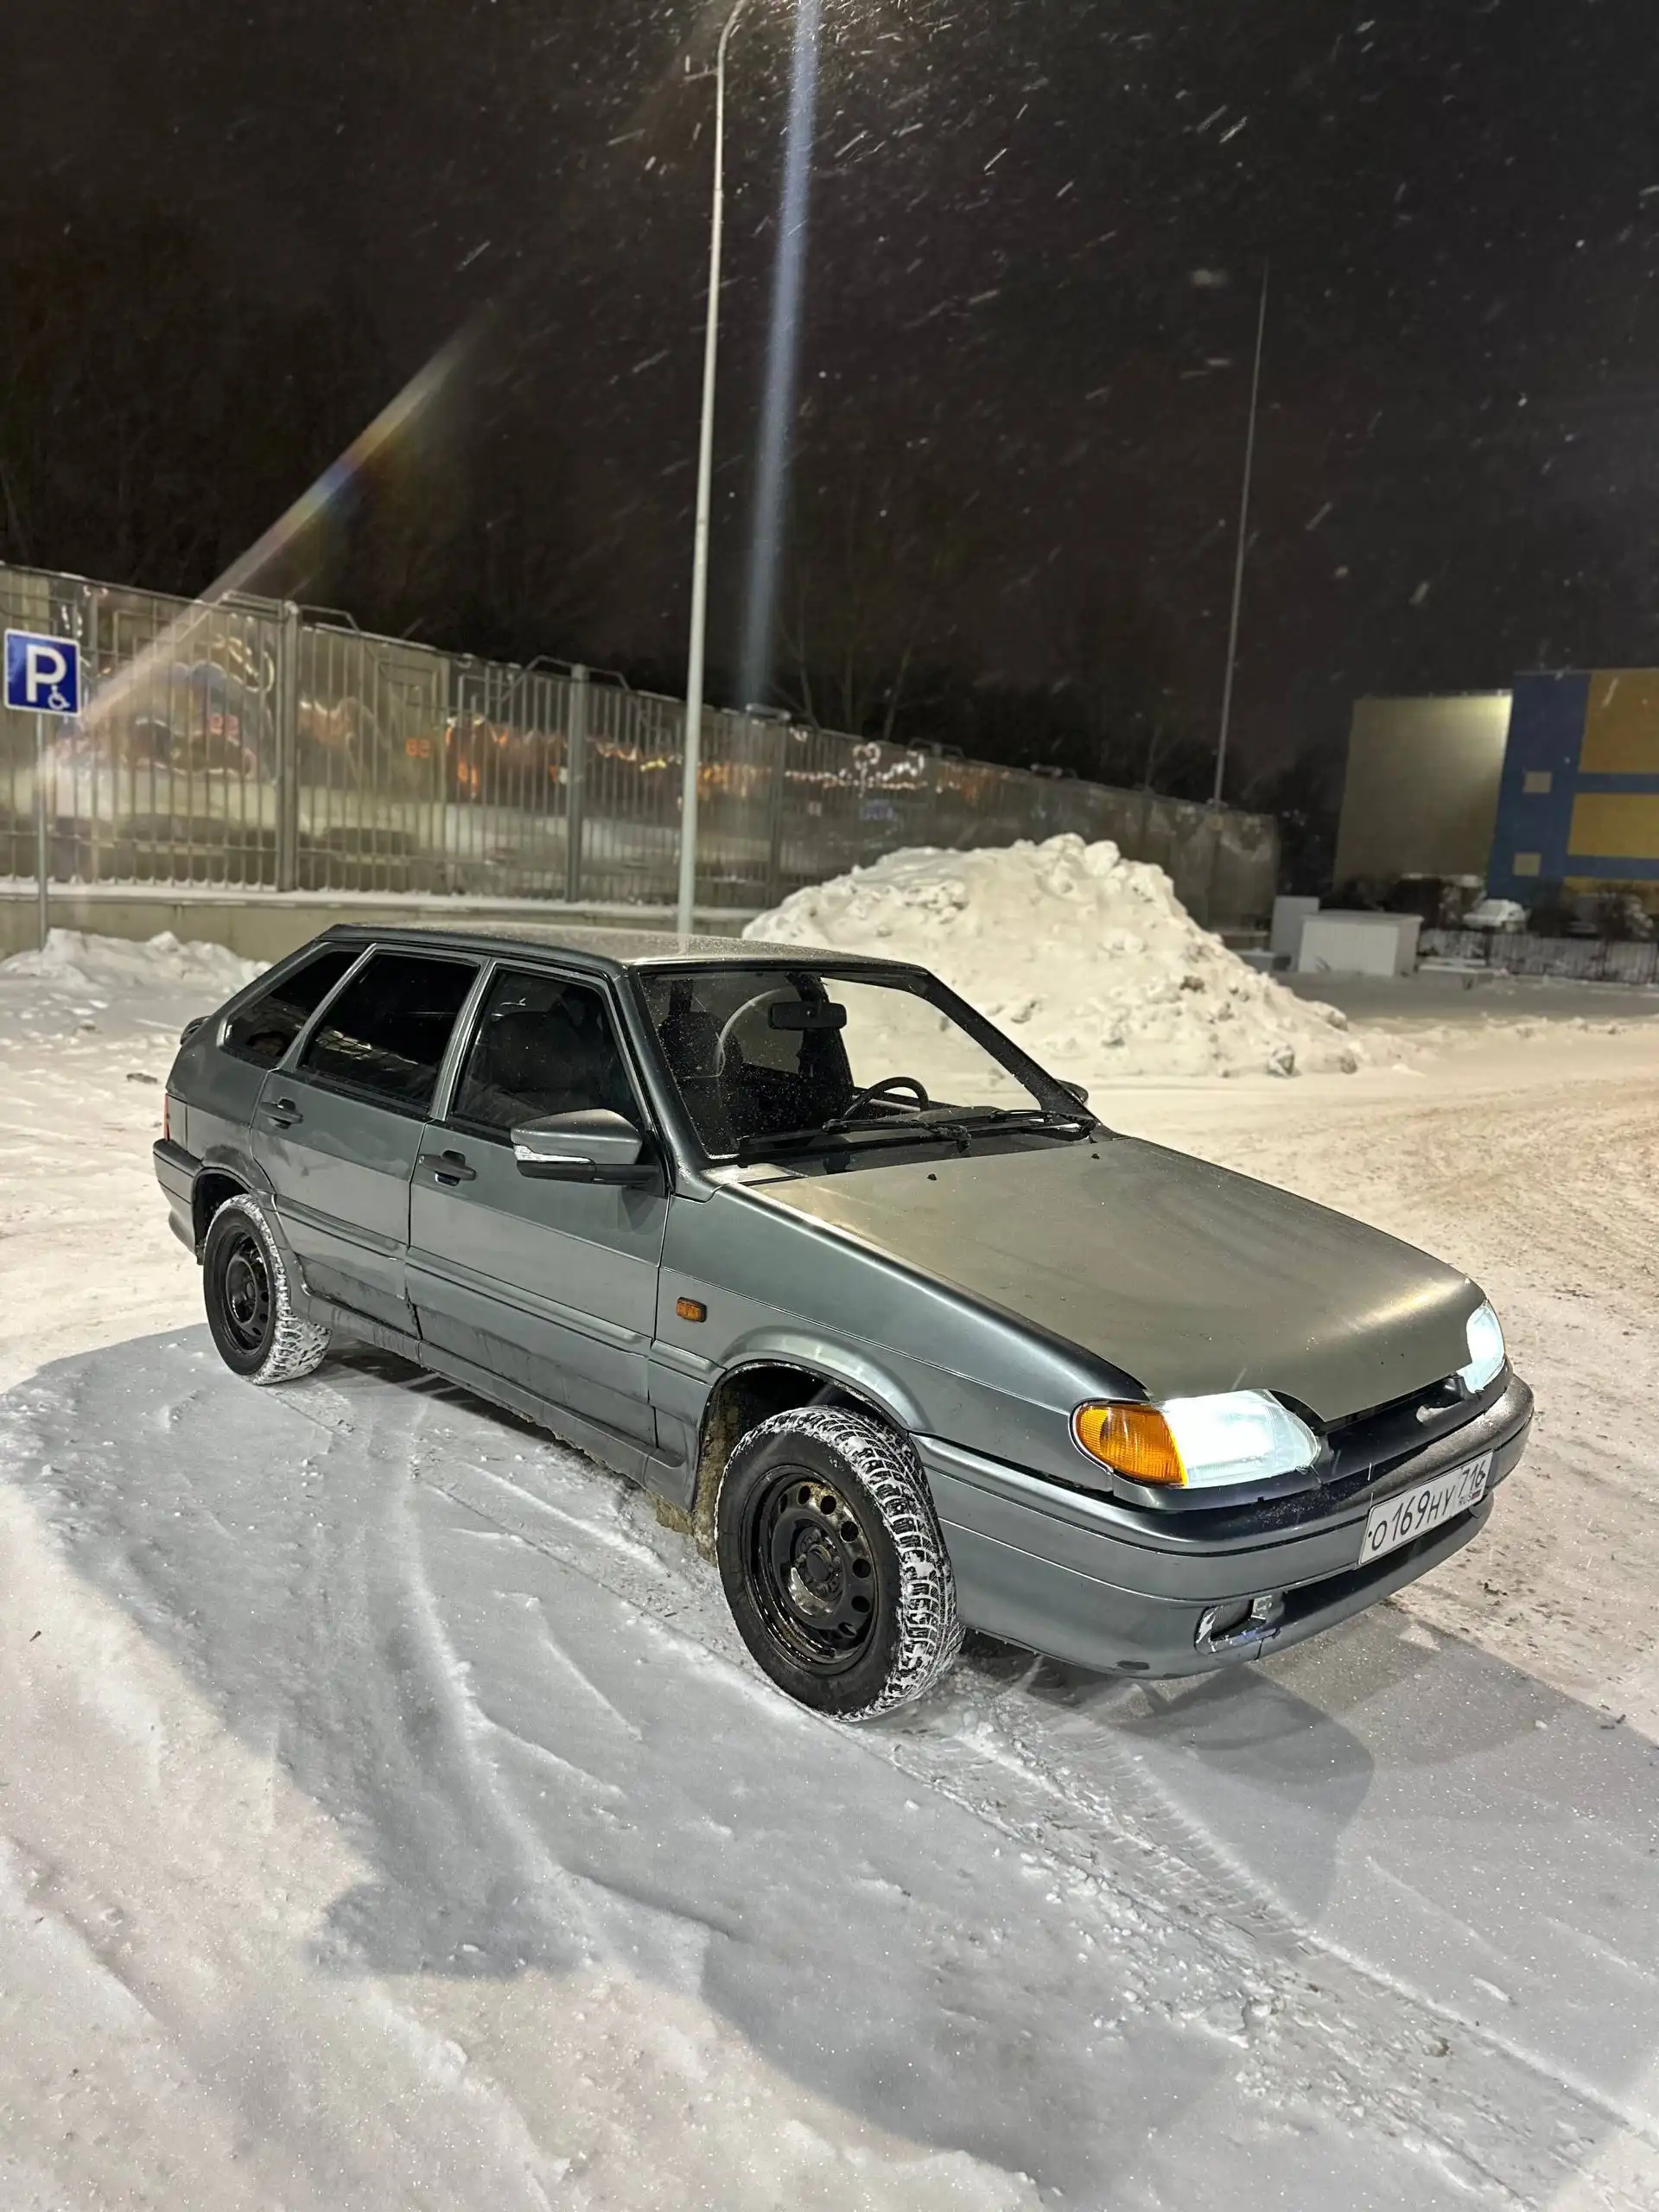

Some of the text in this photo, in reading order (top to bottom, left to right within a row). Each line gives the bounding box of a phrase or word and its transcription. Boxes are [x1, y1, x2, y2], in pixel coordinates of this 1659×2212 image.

[26, 643, 67, 703] P
[1371, 1459, 1486, 1551] О169НУ 716
